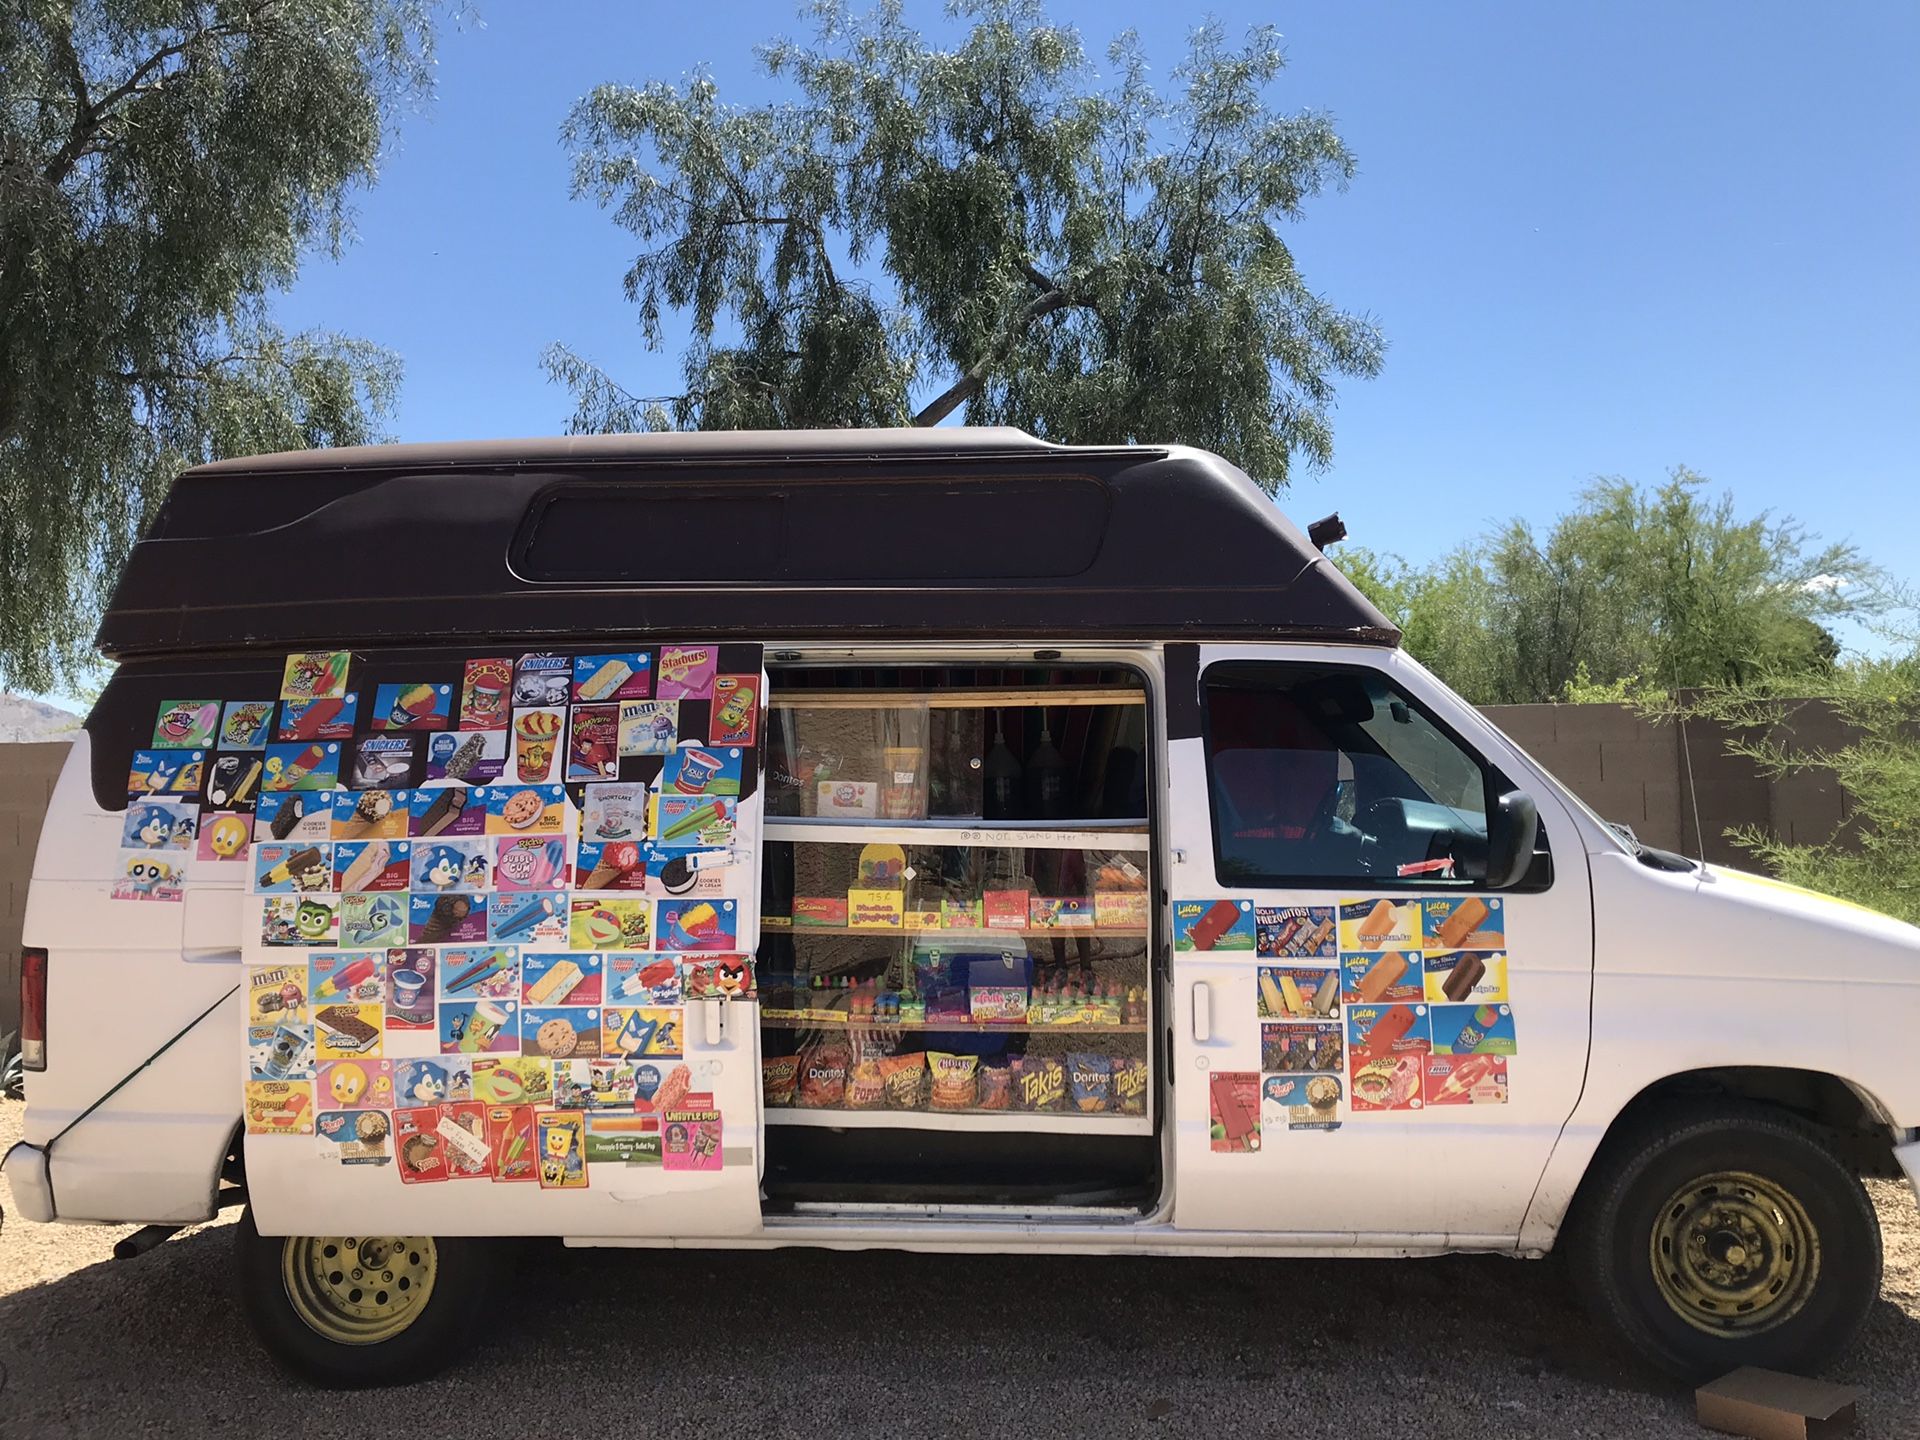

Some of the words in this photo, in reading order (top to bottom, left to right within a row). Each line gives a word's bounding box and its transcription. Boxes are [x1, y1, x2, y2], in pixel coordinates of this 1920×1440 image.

[522, 658, 565, 669] SNICKERS
[662, 650, 708, 669] Starburst
[467, 666, 486, 684] CRY
[364, 739, 406, 751] SNICKERS
[502, 854, 533, 864] BUBBLE
[509, 863, 531, 874] GUM
[1178, 904, 1202, 916] Lucas
[1426, 901, 1451, 912] Lucas
[1256, 908, 1310, 925] FREZQUITOS!
[1345, 956, 1369, 968] Lucas
[1352, 1008, 1377, 1020] Lucas
[325, 1039, 361, 1049] Sandwich
[809, 1067, 845, 1079] Doritos
[886, 1067, 921, 1090] Cheetos
[1073, 1072, 1110, 1084] Doritos
[1021, 1065, 1064, 1105] Takis
[1114, 1065, 1147, 1096] Takis
[665, 1111, 701, 1122] WHISTLE
[702, 1111, 720, 1121] POP
